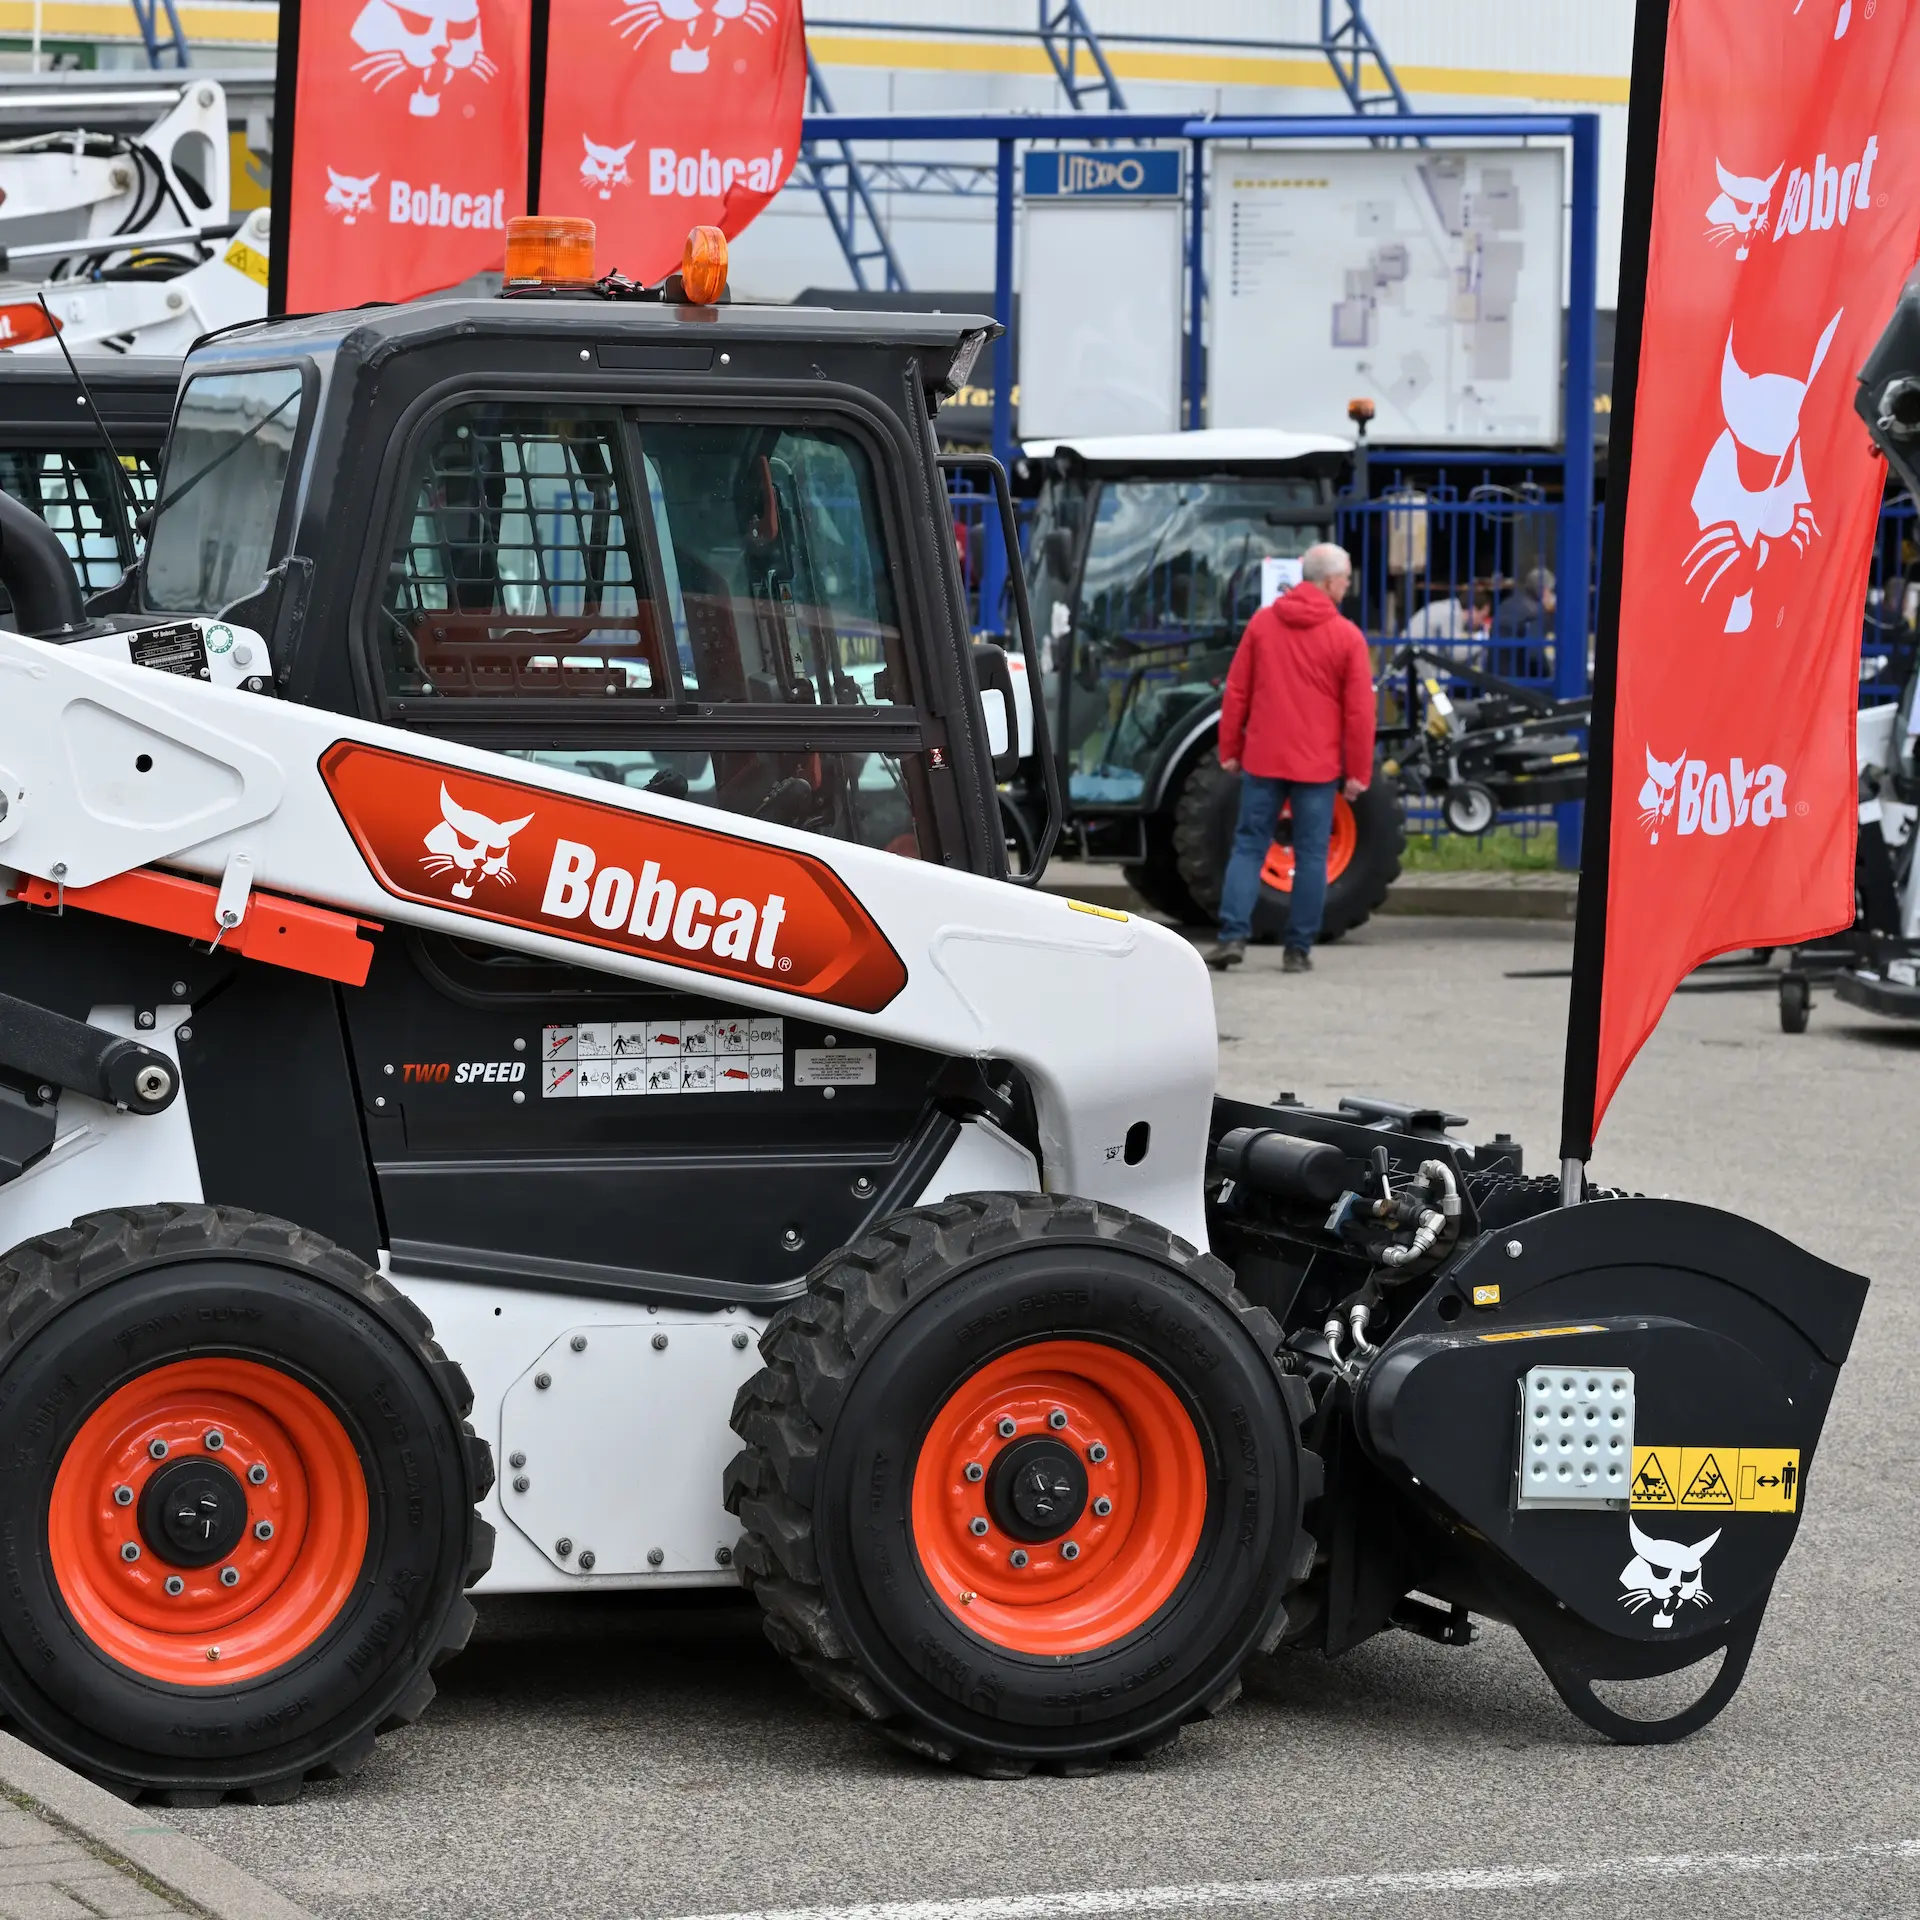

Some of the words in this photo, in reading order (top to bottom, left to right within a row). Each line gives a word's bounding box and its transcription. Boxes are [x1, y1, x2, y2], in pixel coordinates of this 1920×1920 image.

[649, 148, 783, 197] Bobcat
[390, 180, 505, 229] Bobcat
[541, 839, 787, 969] Bobcat
[402, 1063, 450, 1083] TWO
[455, 1062, 526, 1083] SPEED
[956, 1305, 1012, 1342] BEAD
[1017, 1291, 1091, 1317] GUARD
[1240, 1487, 1258, 1548] DUTY
